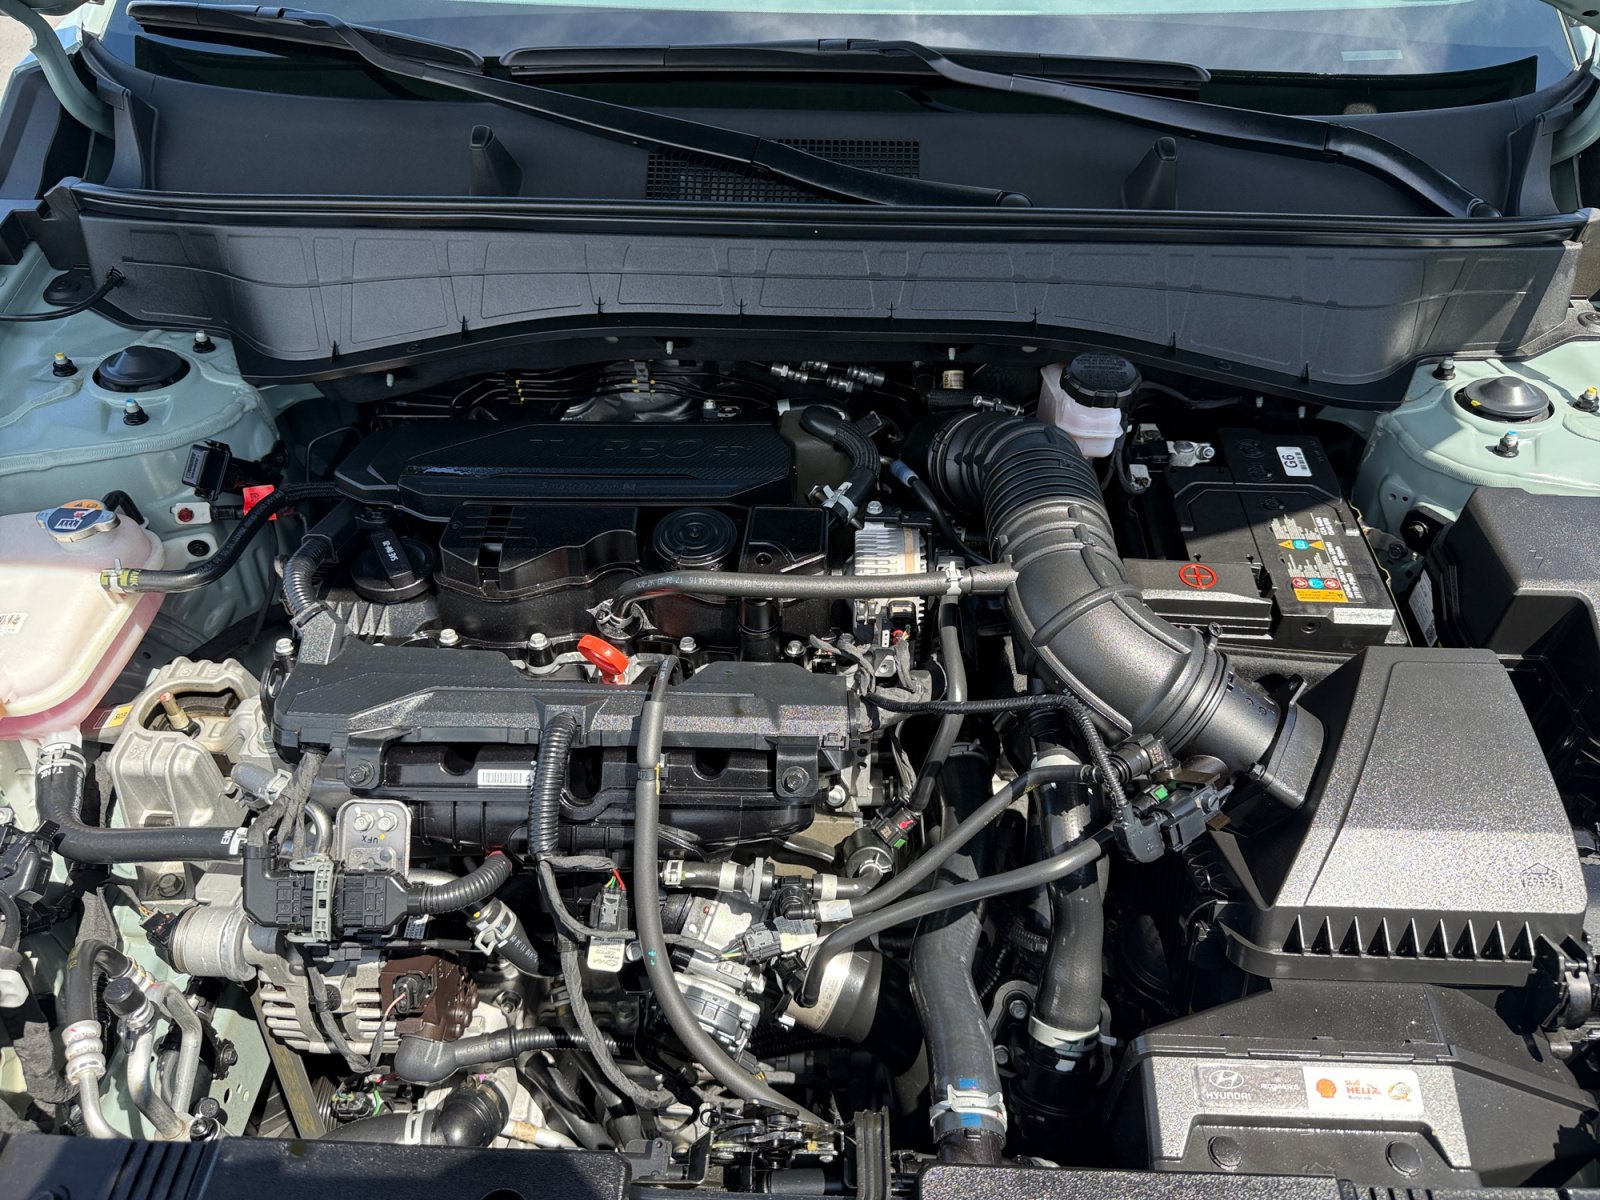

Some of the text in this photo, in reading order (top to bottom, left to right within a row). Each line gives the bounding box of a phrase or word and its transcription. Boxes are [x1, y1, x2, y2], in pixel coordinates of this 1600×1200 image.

[528, 438, 704, 459] TURBO
[1281, 454, 1298, 469] G6
[220, 829, 235, 845] ENG
[361, 834, 379, 845] UFX
[1206, 1091, 1251, 1101] HYUNDAI
[1346, 1085, 1382, 1095] HELIX
